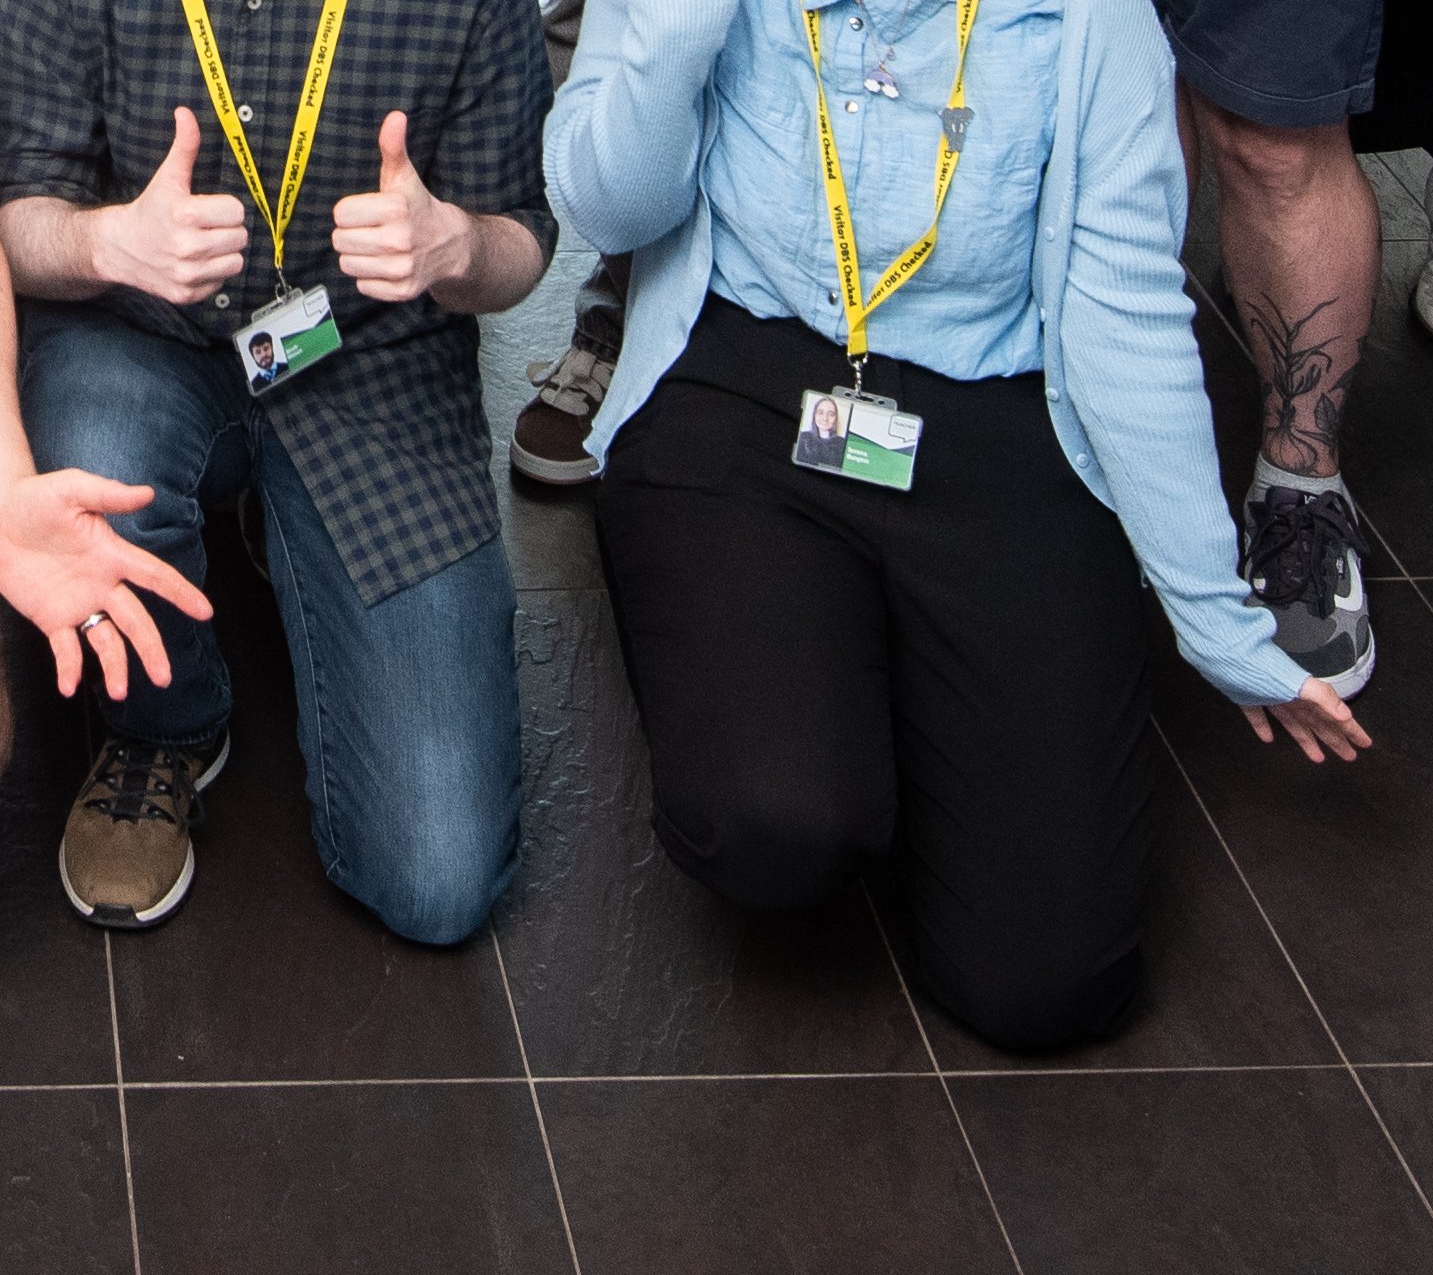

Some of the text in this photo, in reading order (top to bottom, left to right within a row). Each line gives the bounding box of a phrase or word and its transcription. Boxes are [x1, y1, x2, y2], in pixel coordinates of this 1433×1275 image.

[833, 204, 857, 307] Visitor DBS Checked
[883, 240, 934, 288] DBS Checked
